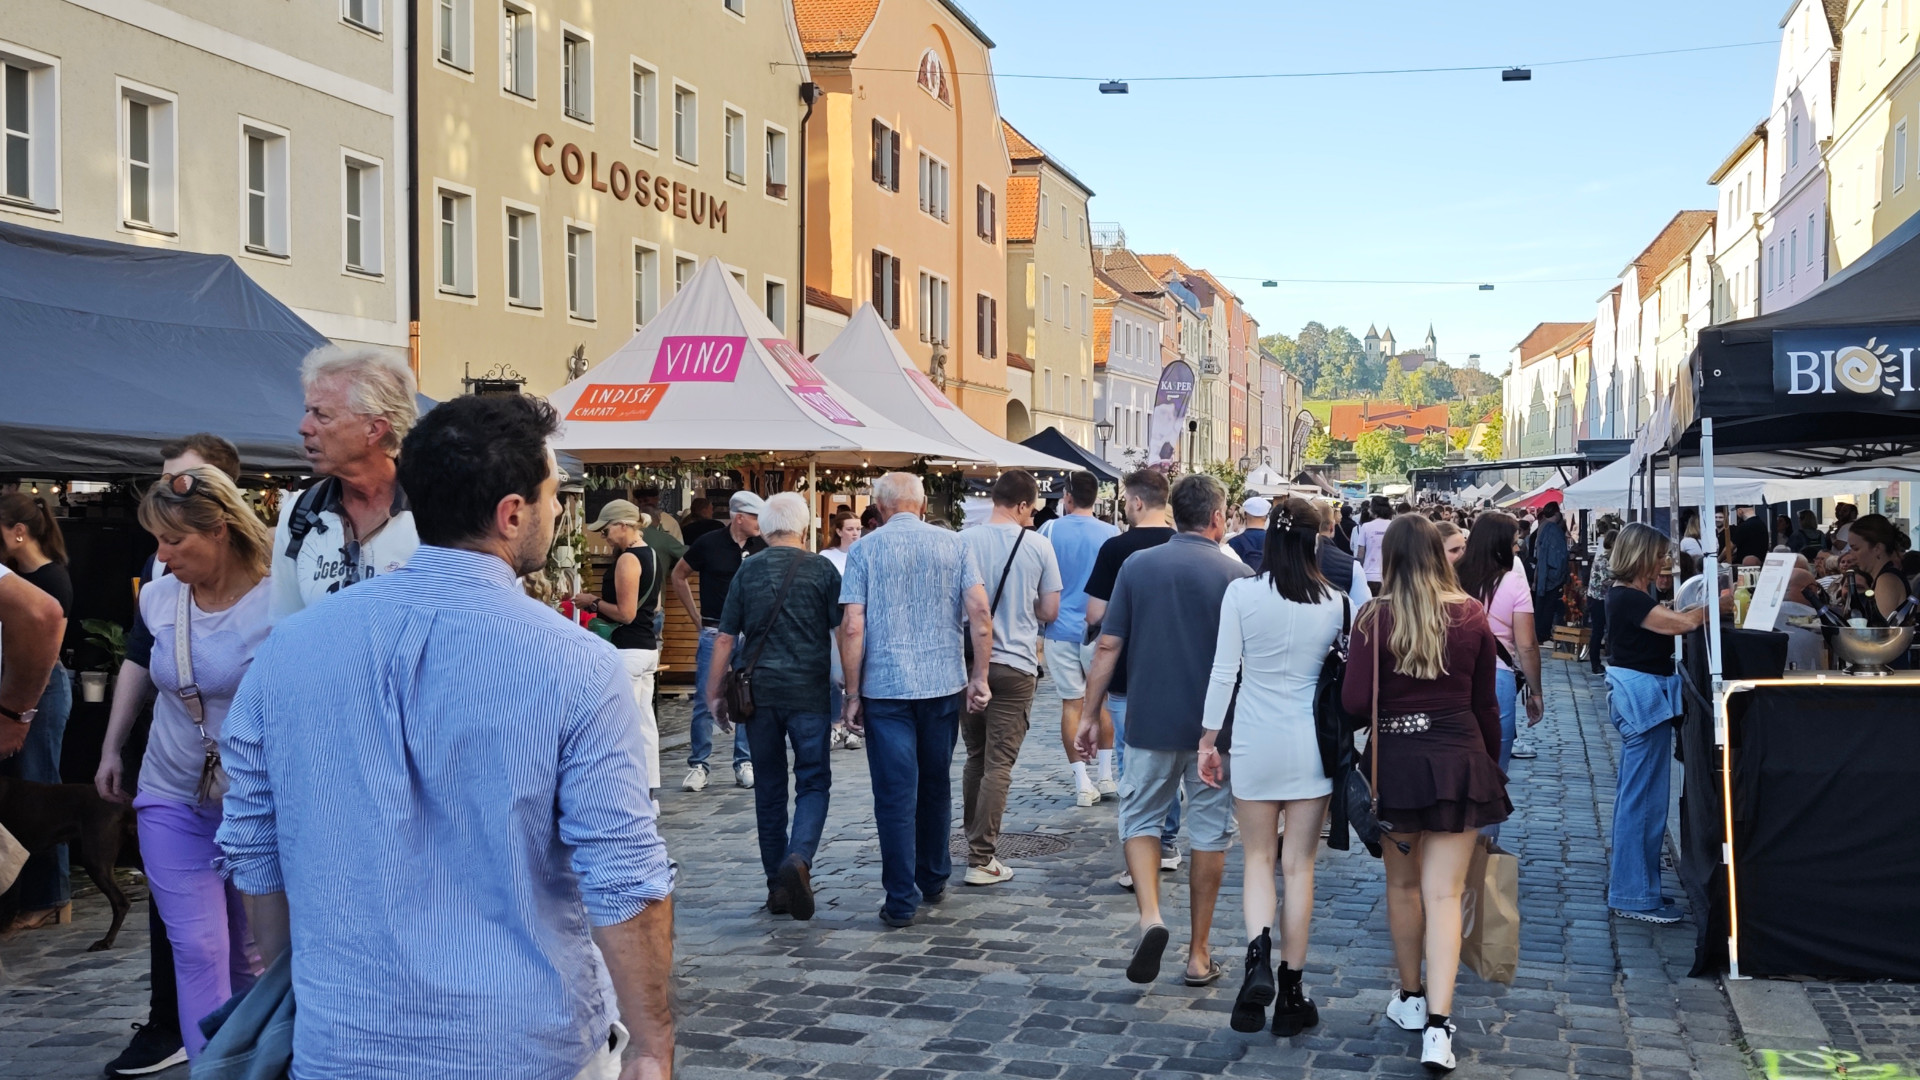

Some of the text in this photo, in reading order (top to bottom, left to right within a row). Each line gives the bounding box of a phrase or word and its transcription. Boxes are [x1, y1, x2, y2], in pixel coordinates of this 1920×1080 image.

[533, 133, 727, 233] COLOSSEUM
[667, 341, 733, 376] VINO
[589, 387, 656, 404] INDISH
[574, 407, 616, 417] CHAPATI
